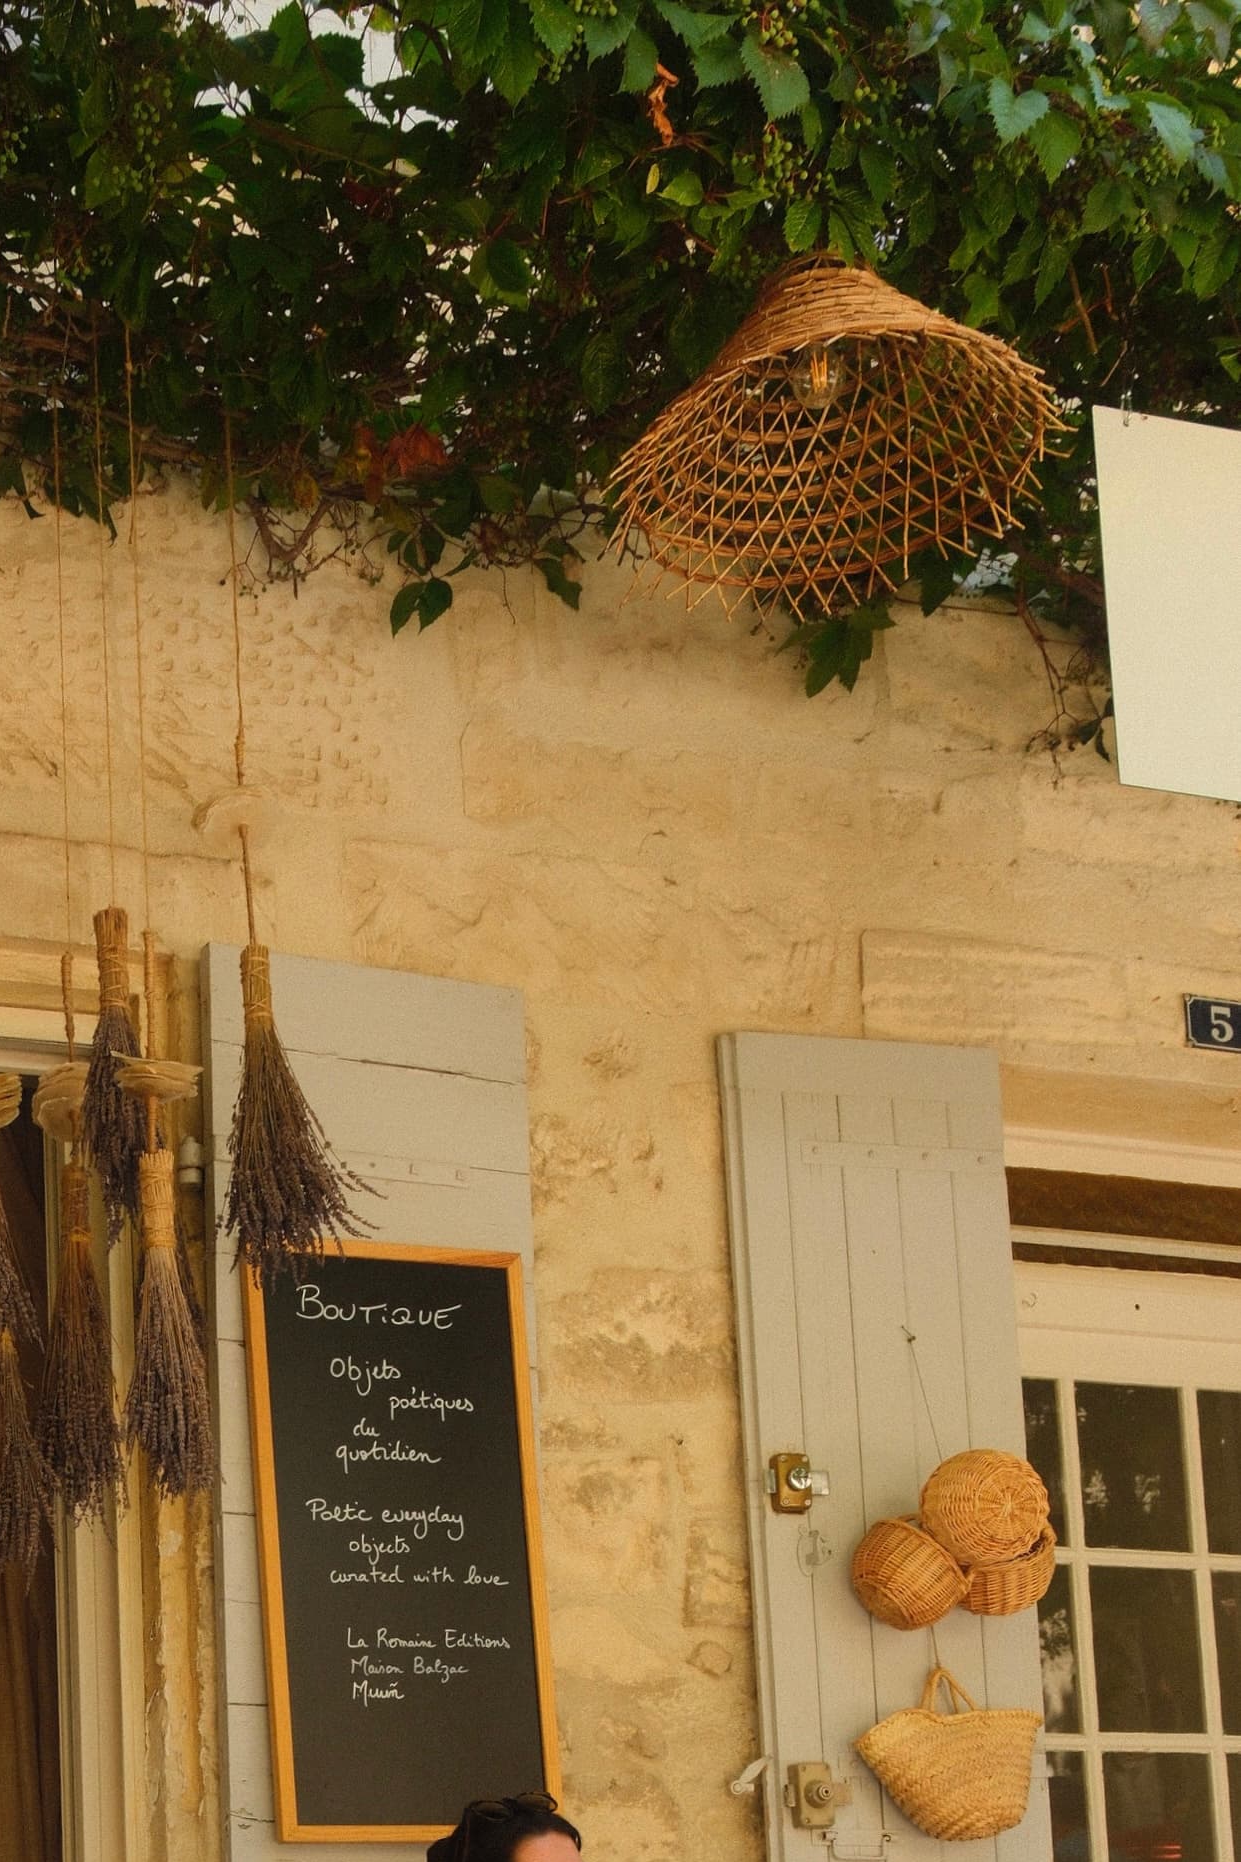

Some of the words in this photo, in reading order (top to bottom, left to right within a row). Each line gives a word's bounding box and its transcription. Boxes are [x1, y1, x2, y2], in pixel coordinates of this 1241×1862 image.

[1210, 1005, 1234, 1043] 5
[330, 1355, 401, 1396] Objets
[389, 1386, 474, 1422] poétiques
[353, 1417, 381, 1437] du
[336, 1440, 442, 1474] quotidien
[305, 1498, 373, 1522] Poetic
[381, 1505, 464, 1541] everyday
[349, 1534, 410, 1565] objects
[329, 1565, 405, 1584] curated
[413, 1566, 455, 1584] with
[463, 1565, 509, 1585] love
[347, 1627, 369, 1648] La
[377, 1627, 437, 1648] Romaine
[445, 1628, 510, 1649] Editions
[351, 1655, 405, 1676] Maison
[413, 1656, 469, 1684] Balzac
